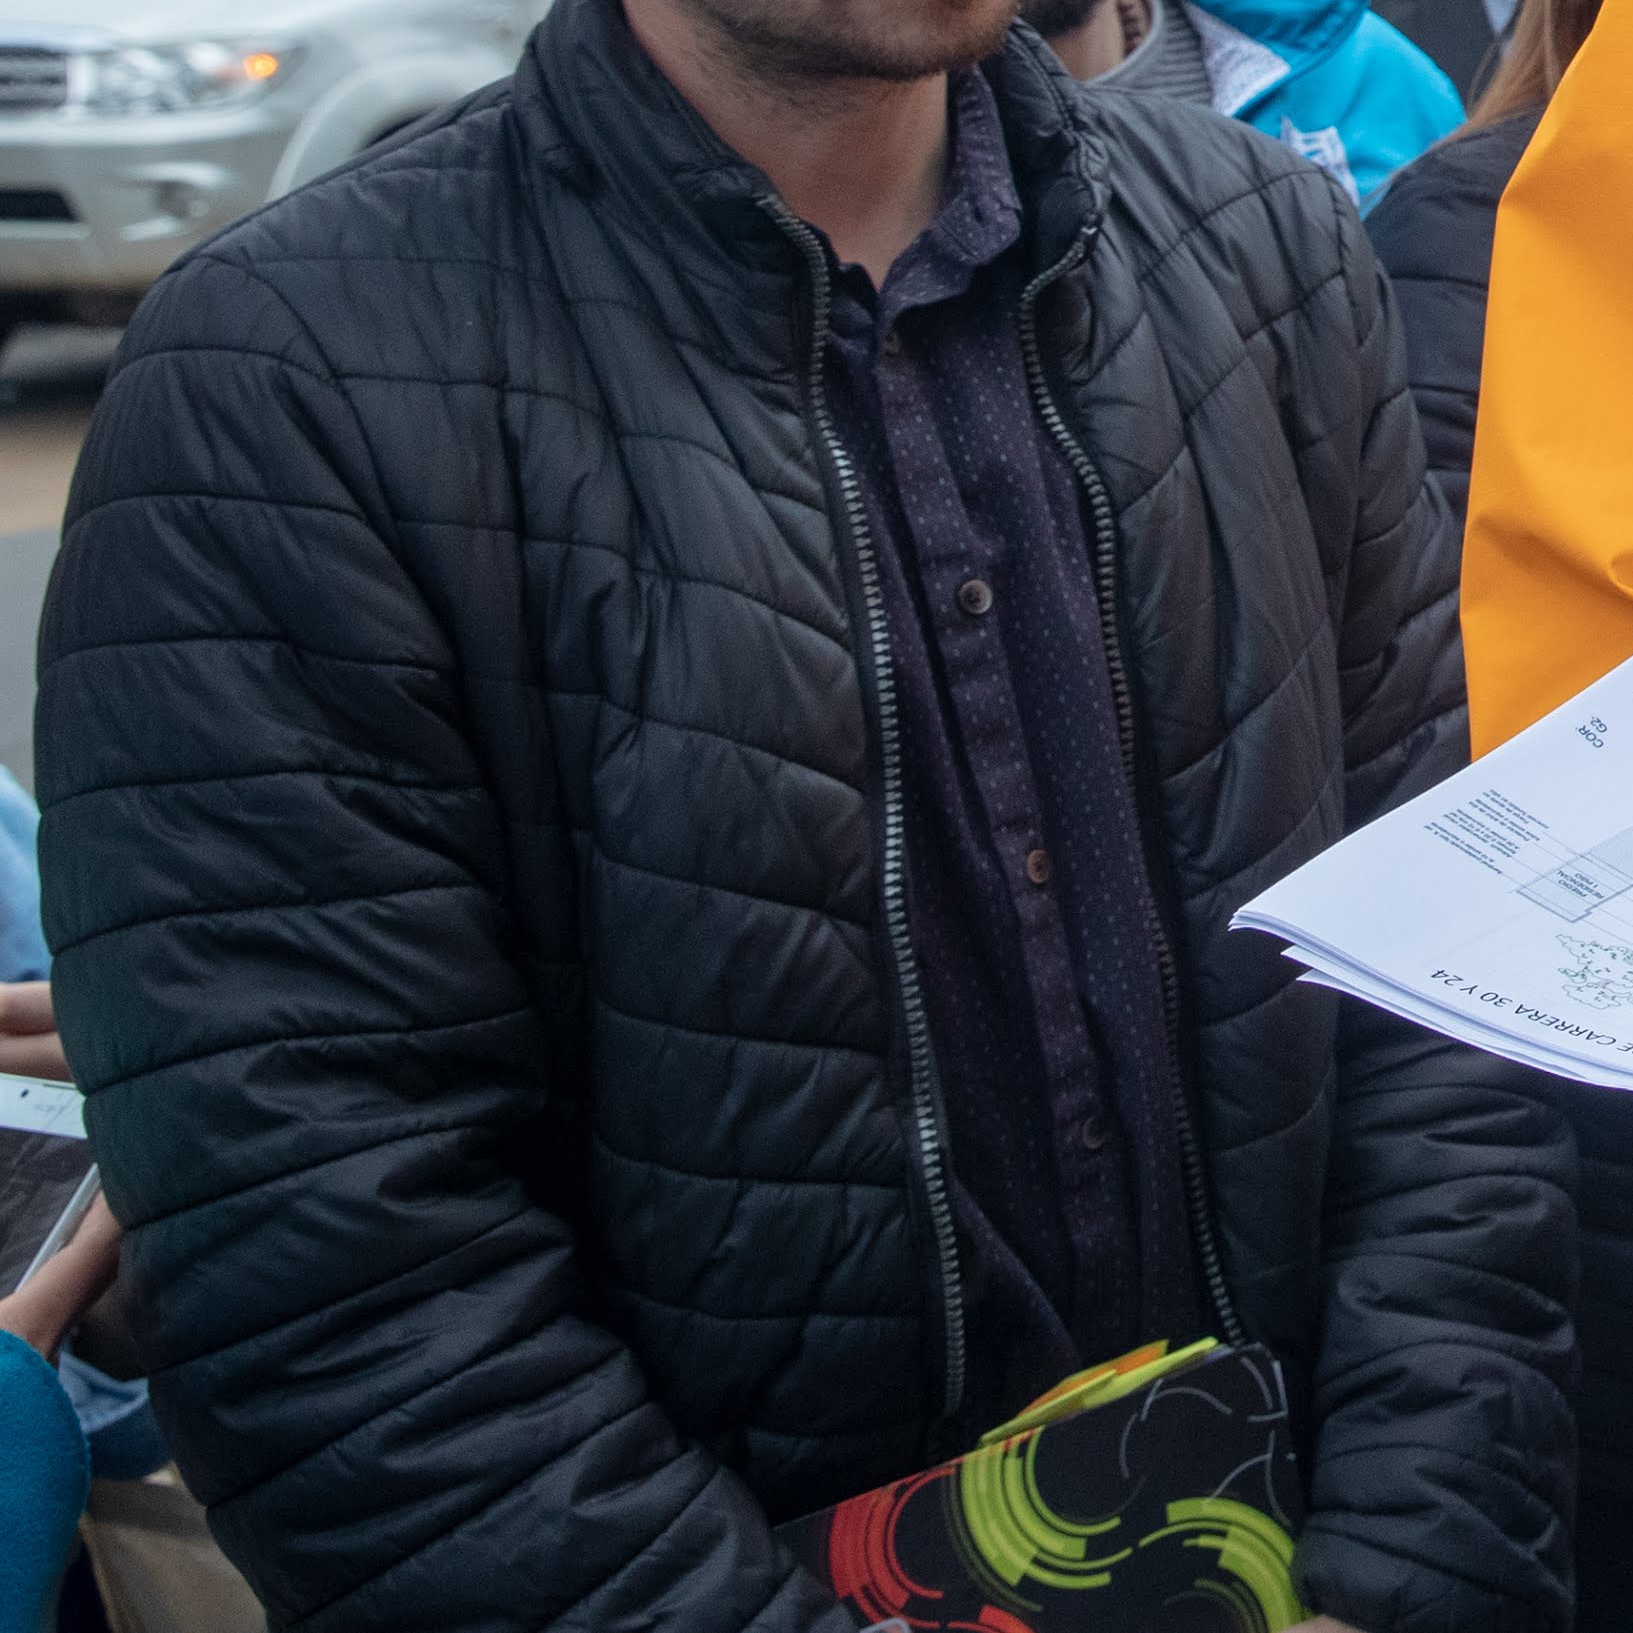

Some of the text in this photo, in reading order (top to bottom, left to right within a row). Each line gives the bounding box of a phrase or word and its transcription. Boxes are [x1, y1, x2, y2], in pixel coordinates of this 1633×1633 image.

[1431, 969, 1463, 986] 24
[1459, 979, 1478, 995] Y
[1480, 992, 1513, 1007] 30
[1515, 1004, 1616, 1045] CARRERA
